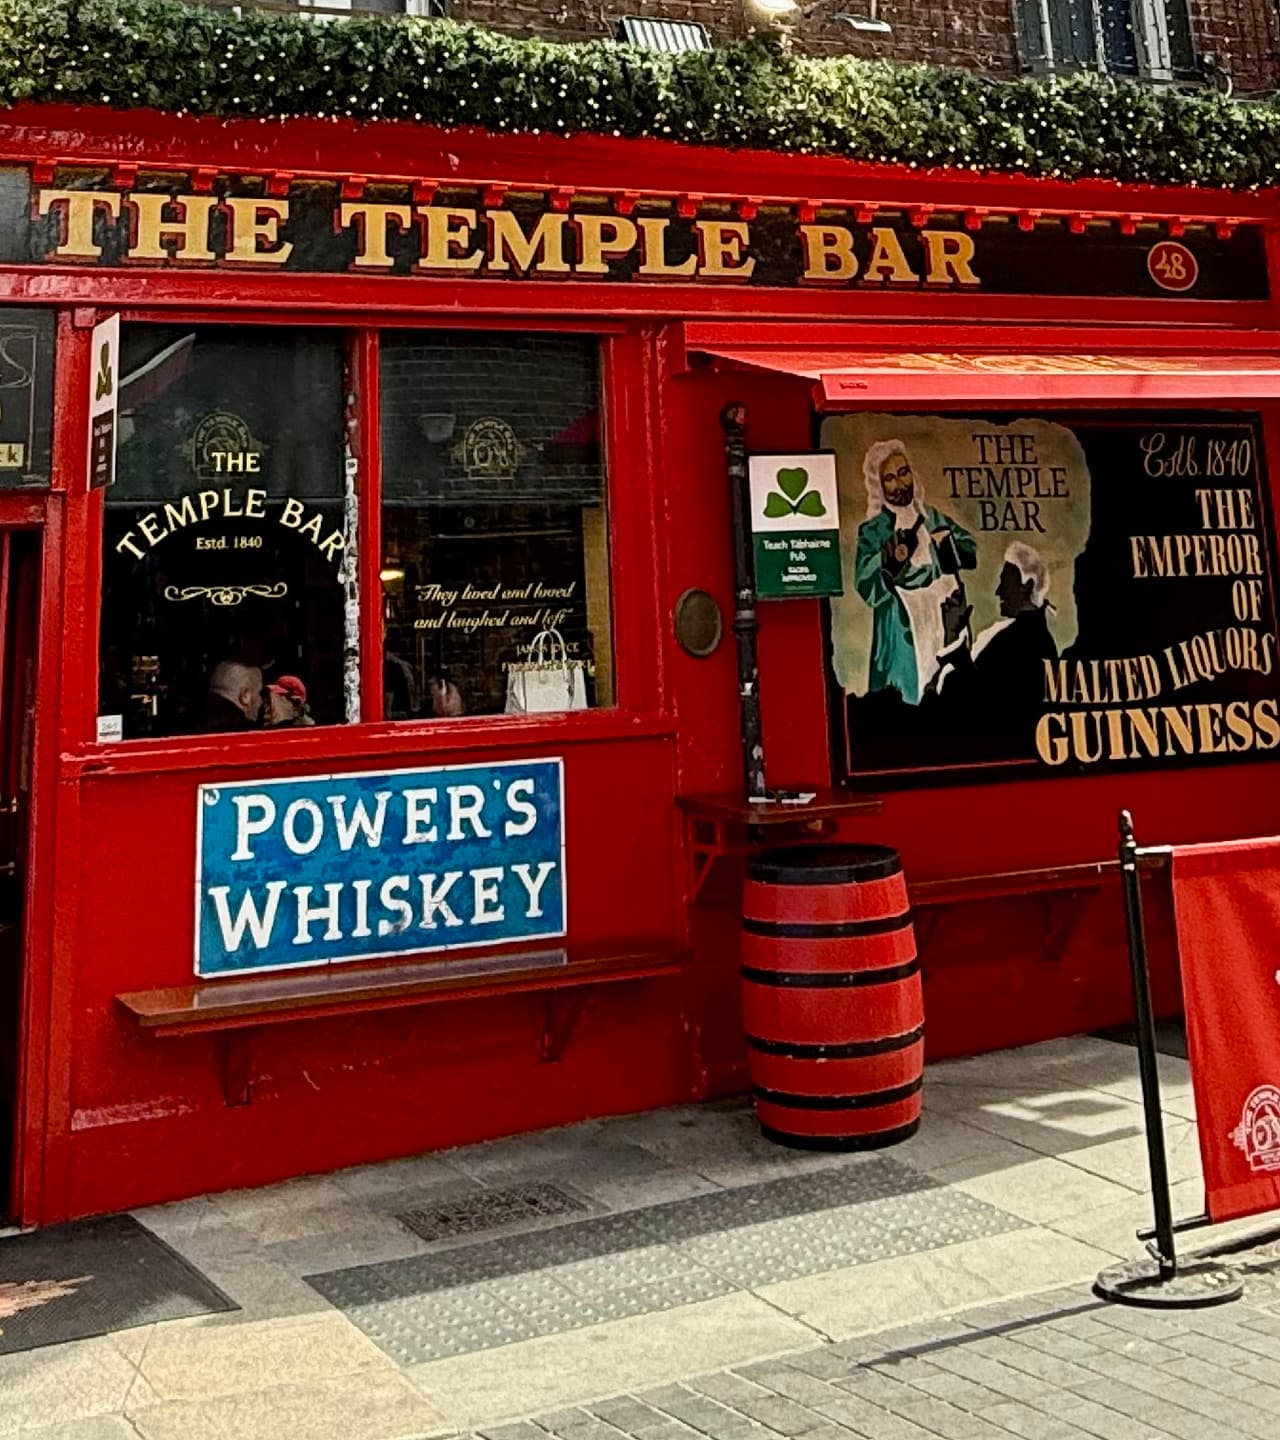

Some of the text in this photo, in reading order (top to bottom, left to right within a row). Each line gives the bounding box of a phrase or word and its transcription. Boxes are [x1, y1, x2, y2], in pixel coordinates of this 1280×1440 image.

[40, 188, 1190, 287] THE TEMPLE BAR 48
[211, 451, 260, 472] THE
[972, 433, 1040, 465] THE
[1206, 436, 1252, 477] 1840
[943, 467, 1070, 499] TEMPLE
[116, 488, 347, 562] TEMPLE BAR
[979, 500, 1046, 533] BAR
[1195, 490, 1255, 530] THE
[195, 535, 263, 550] Estd. 1840
[1131, 534, 1264, 579] EMPEROR
[1231, 579, 1263, 622] OF
[1042, 626, 1276, 705] MALTED LIQUORS
[231, 778, 539, 861] POWER'S
[207, 862, 557, 953] WHISKEY
